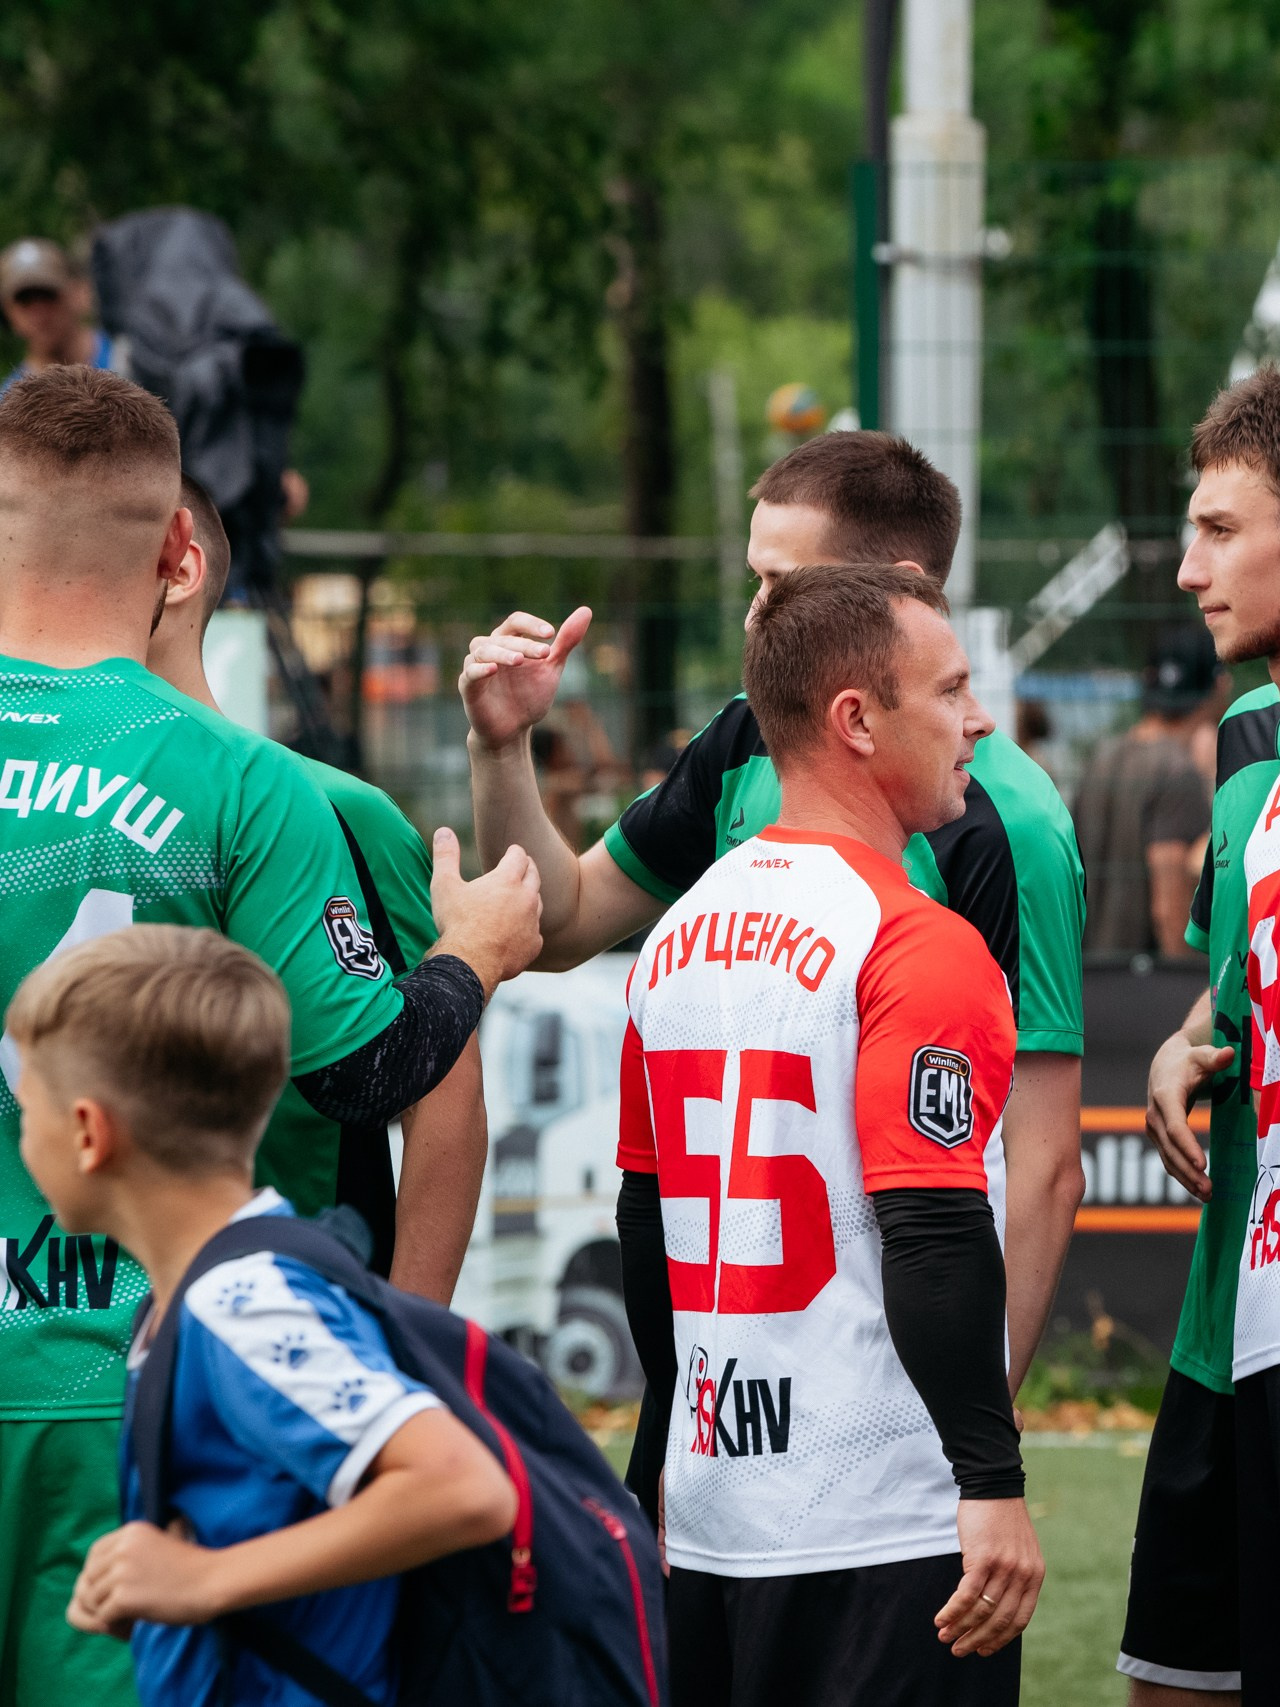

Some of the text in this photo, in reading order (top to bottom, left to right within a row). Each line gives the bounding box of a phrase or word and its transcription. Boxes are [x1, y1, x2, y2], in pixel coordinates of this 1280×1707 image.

[0, 711, 62, 725] AVEX
[648, 912, 835, 992] ЛУЦЕНКО
[643, 1048, 837, 1314] 55
